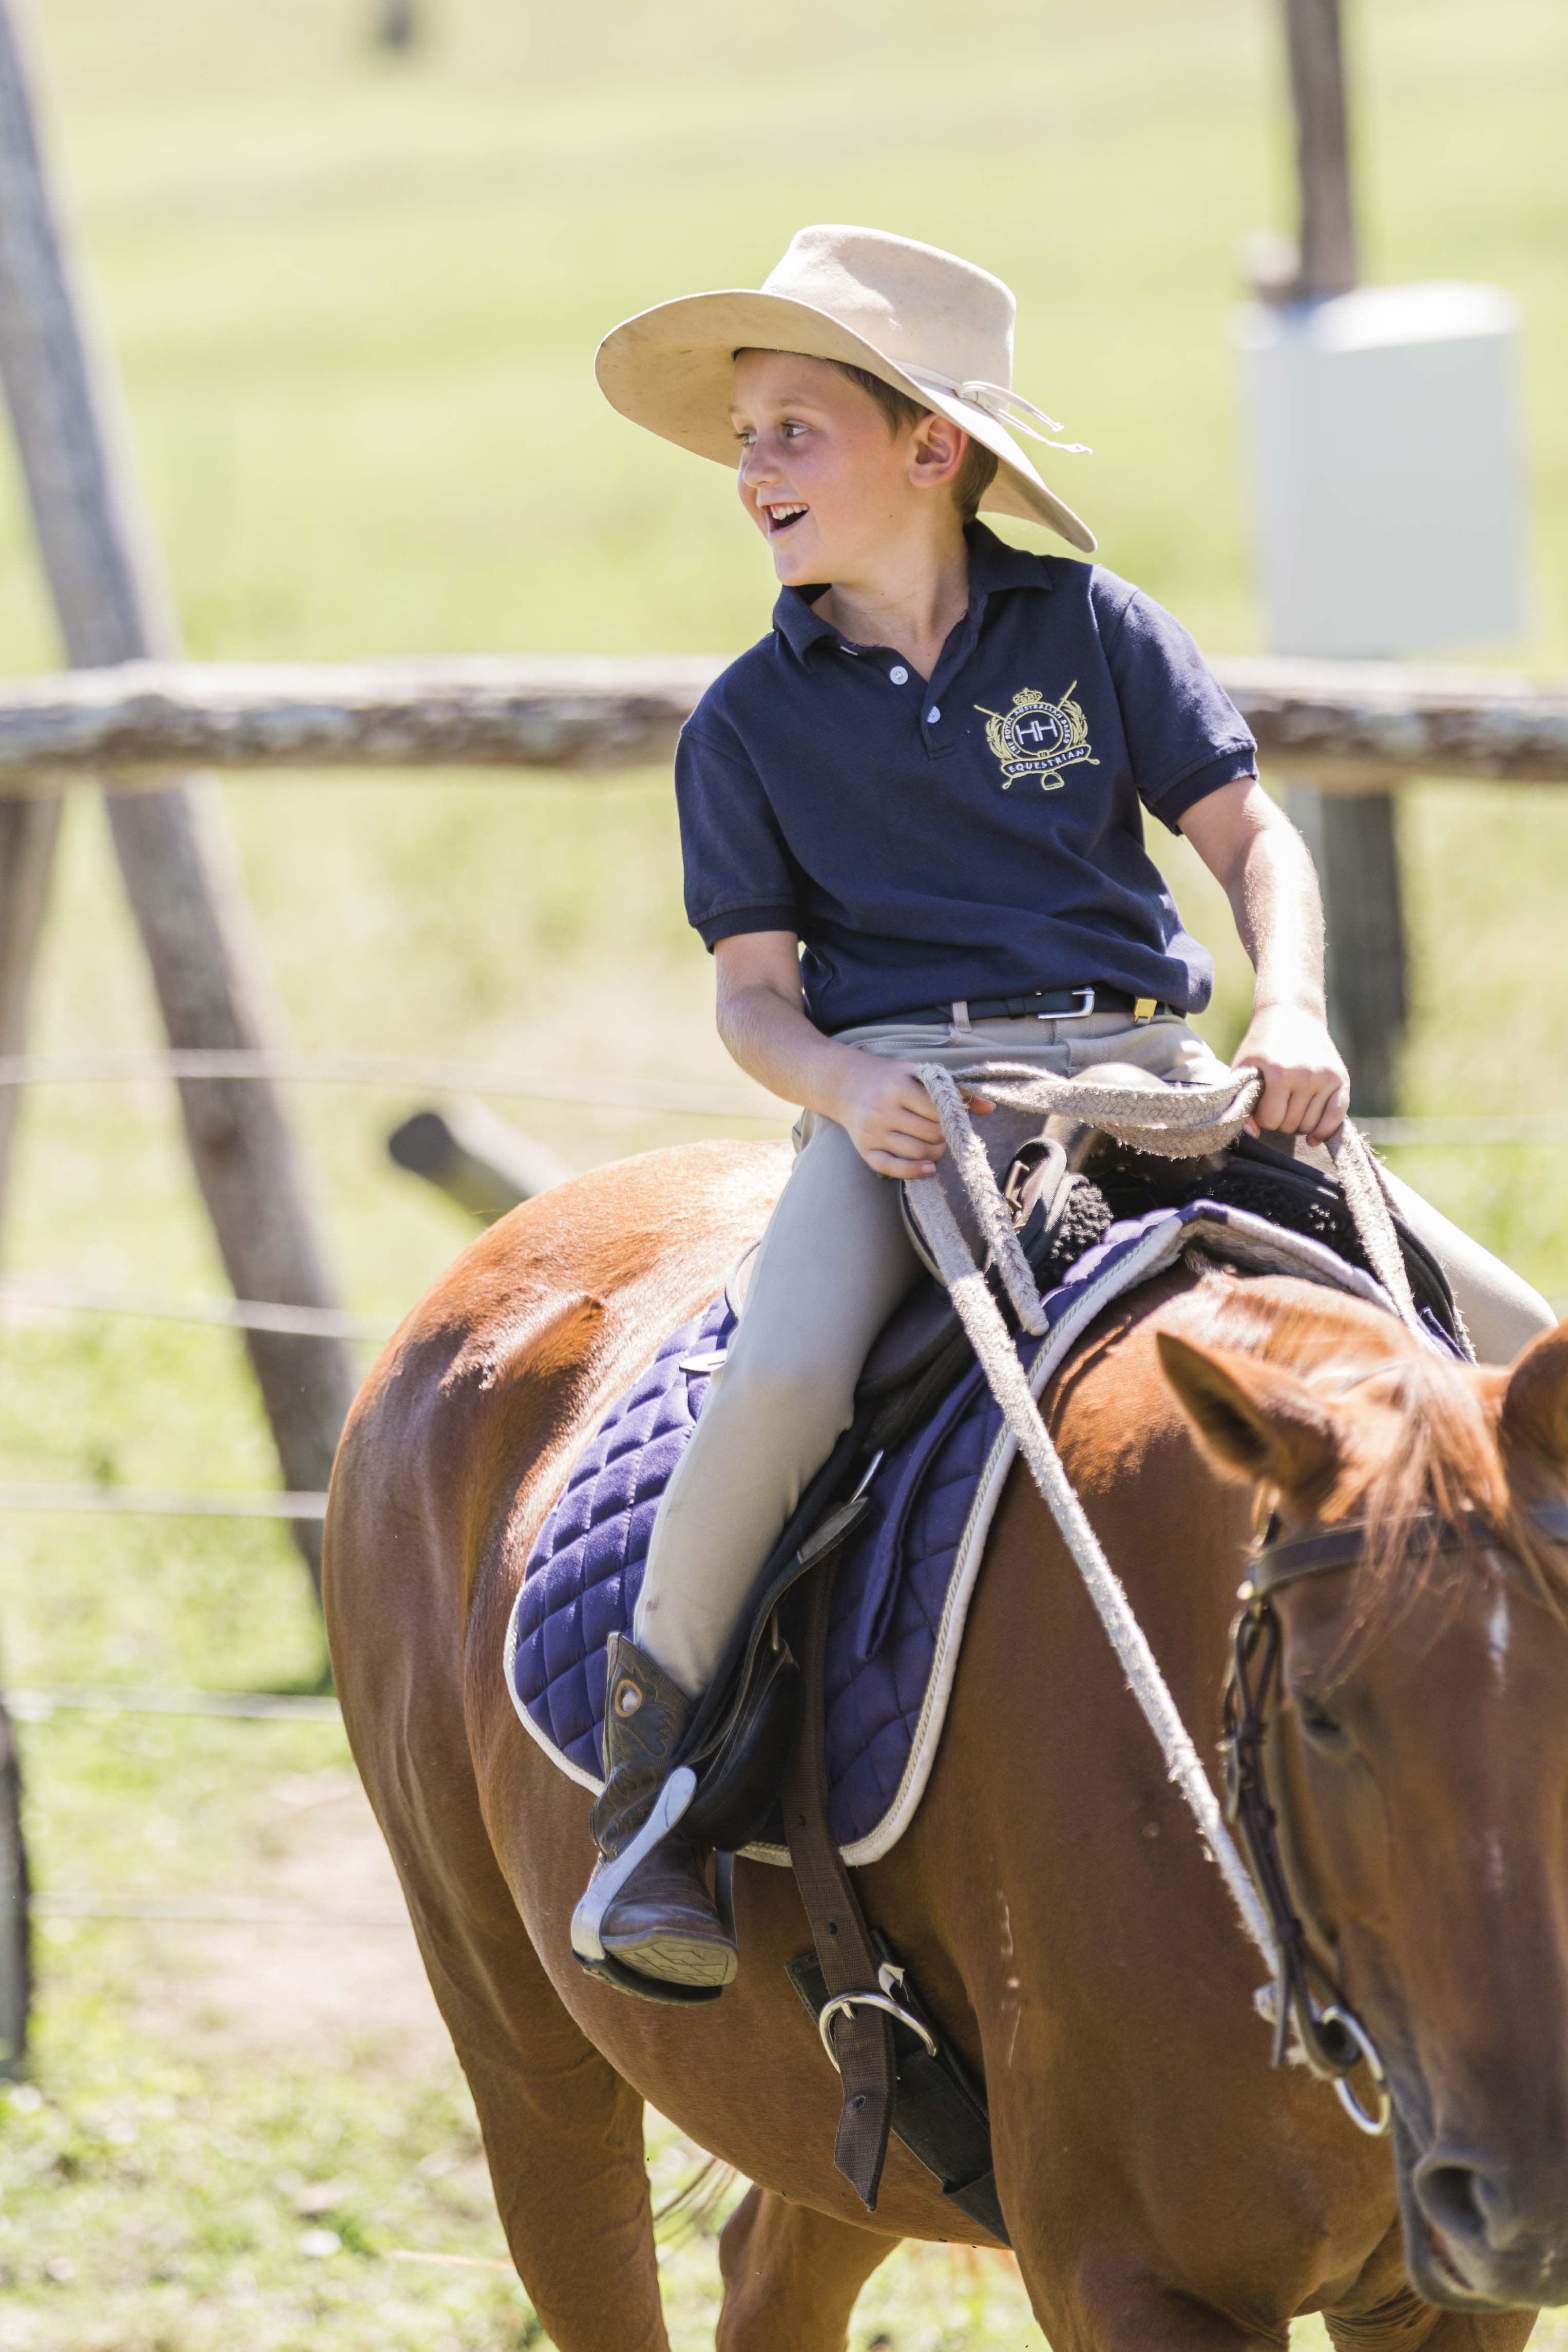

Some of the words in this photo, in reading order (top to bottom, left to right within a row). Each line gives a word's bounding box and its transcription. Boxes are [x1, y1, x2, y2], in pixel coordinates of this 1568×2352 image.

[1014, 704, 1063, 719] AUSTRALIAN
[1004, 717, 1015, 740] ROYAL
[1061, 719, 1070, 744] BREED
[1008, 741, 1021, 754] THE
[1008, 748, 1084, 773] EQUESTRIAN
